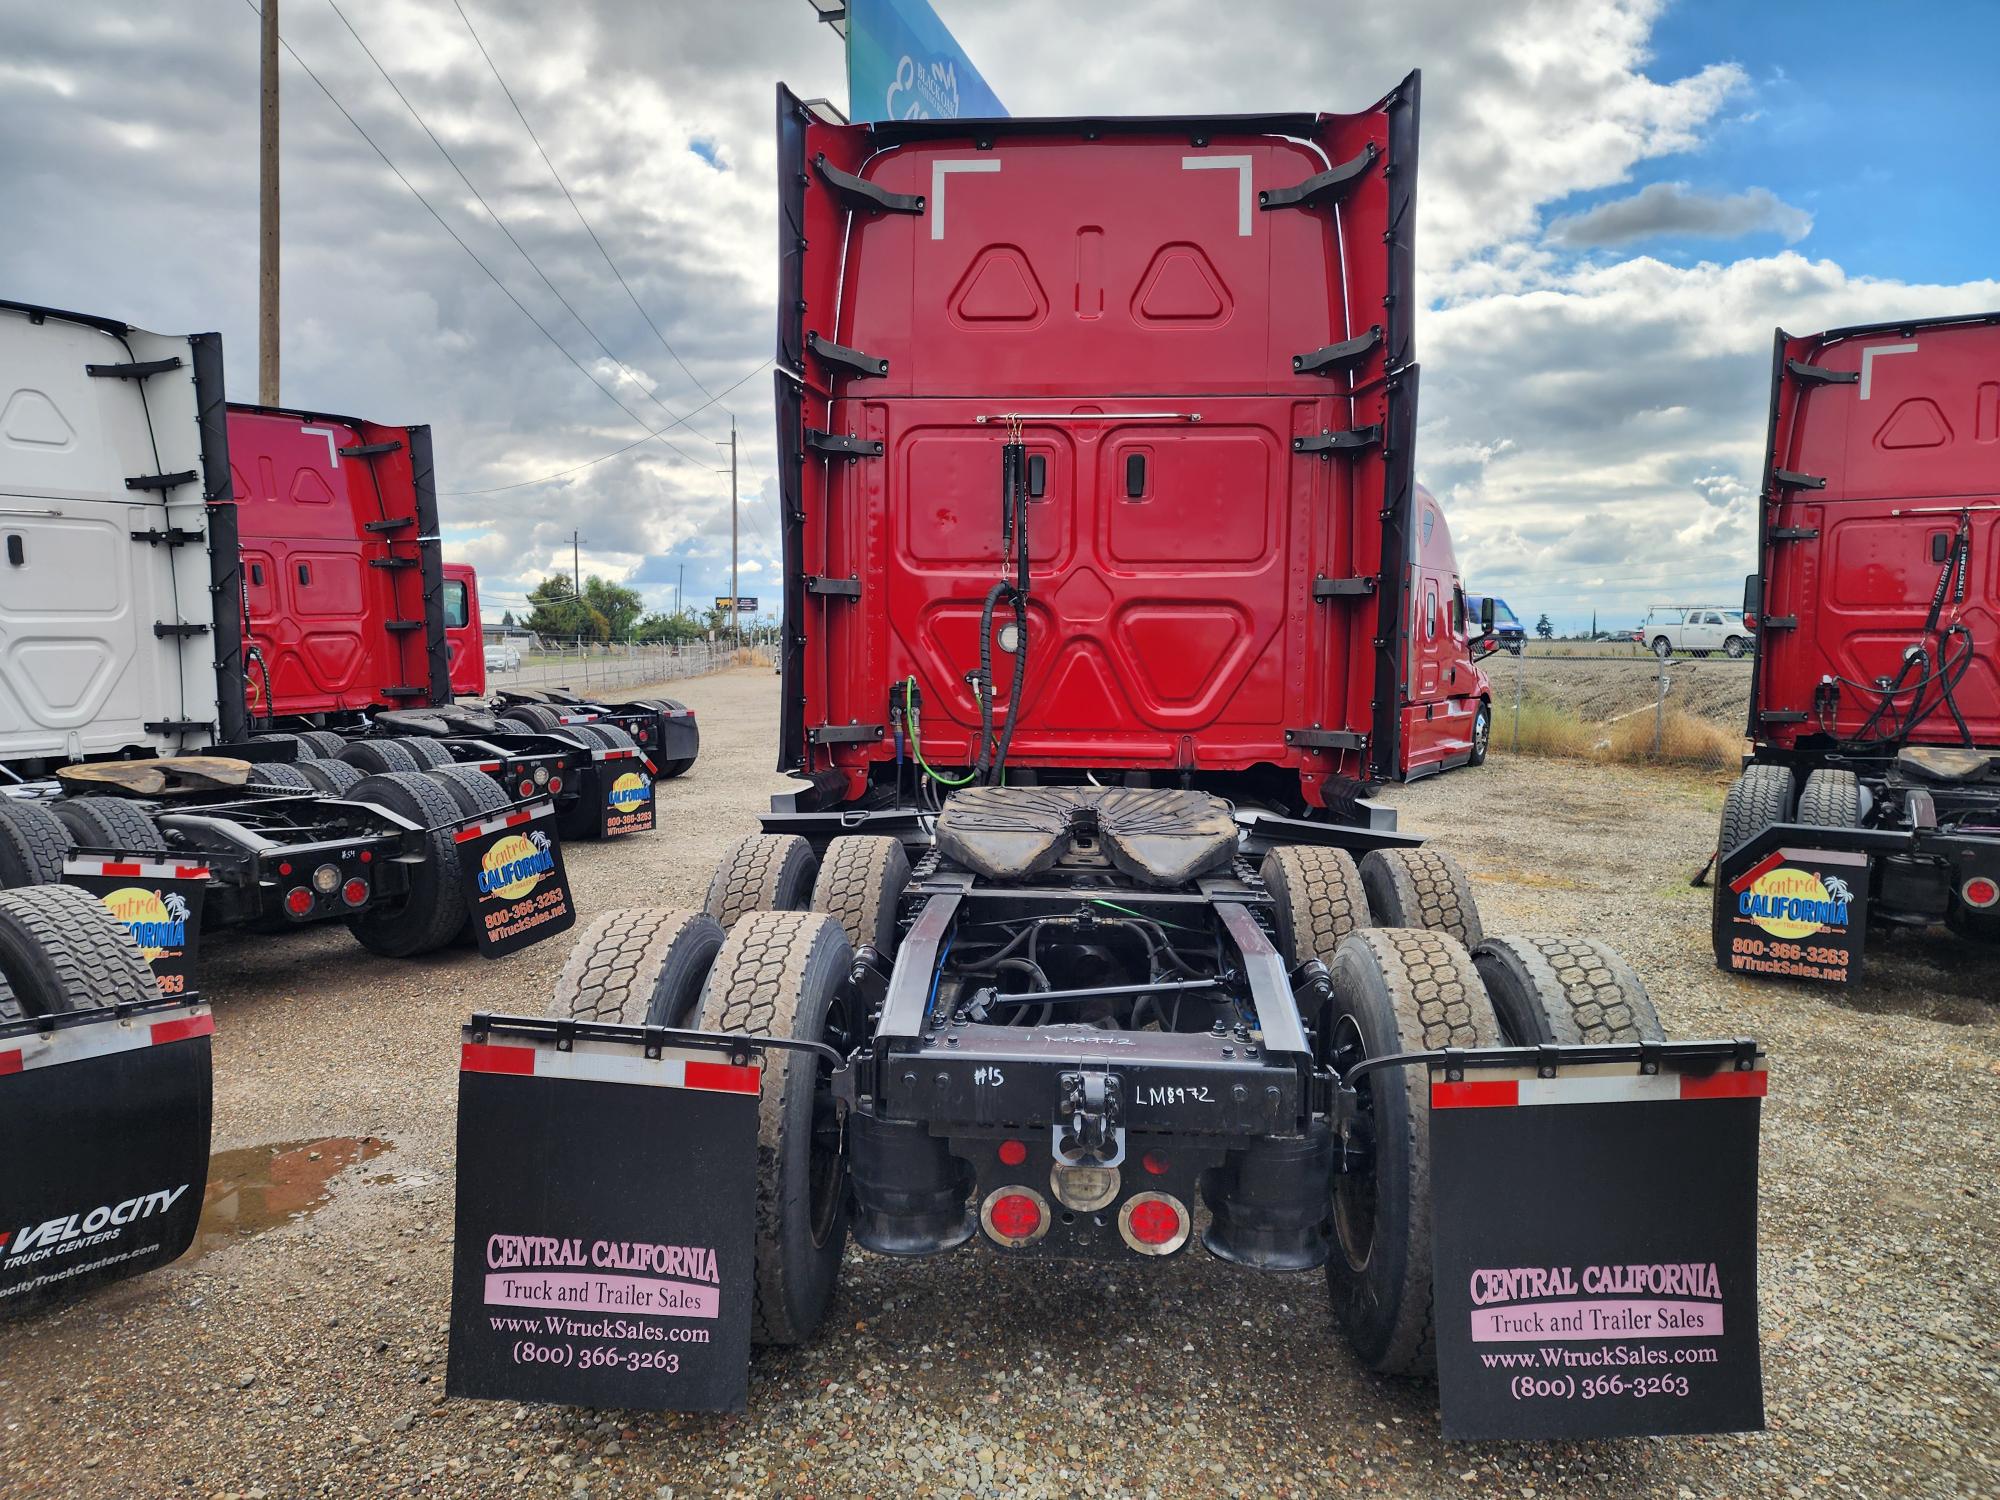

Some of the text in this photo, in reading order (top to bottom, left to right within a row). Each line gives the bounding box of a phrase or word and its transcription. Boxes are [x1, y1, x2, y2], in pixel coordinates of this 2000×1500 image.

[482, 832, 528, 870] Central
[478, 848, 554, 893] CALIFORNIA
[1750, 872, 1821, 895] Central
[484, 887, 564, 929] 800-366-3263
[487, 902, 567, 942] WTruckSales.net
[1739, 891, 1848, 926] CALIFORNIA
[1732, 937, 1849, 966] 800-366-3263
[1731, 954, 1848, 982] WTruckSales.net
[974, 1066, 1004, 1087] #15
[1135, 1085, 1215, 1106] LM8972
[11, 1184, 190, 1255] VELOCITY
[3, 1227, 121, 1271] TRUCK CENTERS
[486, 1233, 720, 1284] CENTRAL CALIFORNIA
[502, 1279, 701, 1310] Truck and Trailer Sales
[1470, 1262, 1723, 1306] CENTRAL CALIFORNIA
[489, 1316, 710, 1343] www.WtruckSales.com
[1490, 1307, 1704, 1333] Truck and Trailer Sales
[513, 1340, 680, 1373] (800) 366-3263
[1480, 1345, 1718, 1368] www.WtruckSales.com
[1511, 1373, 1690, 1400] (800) 366-3263
